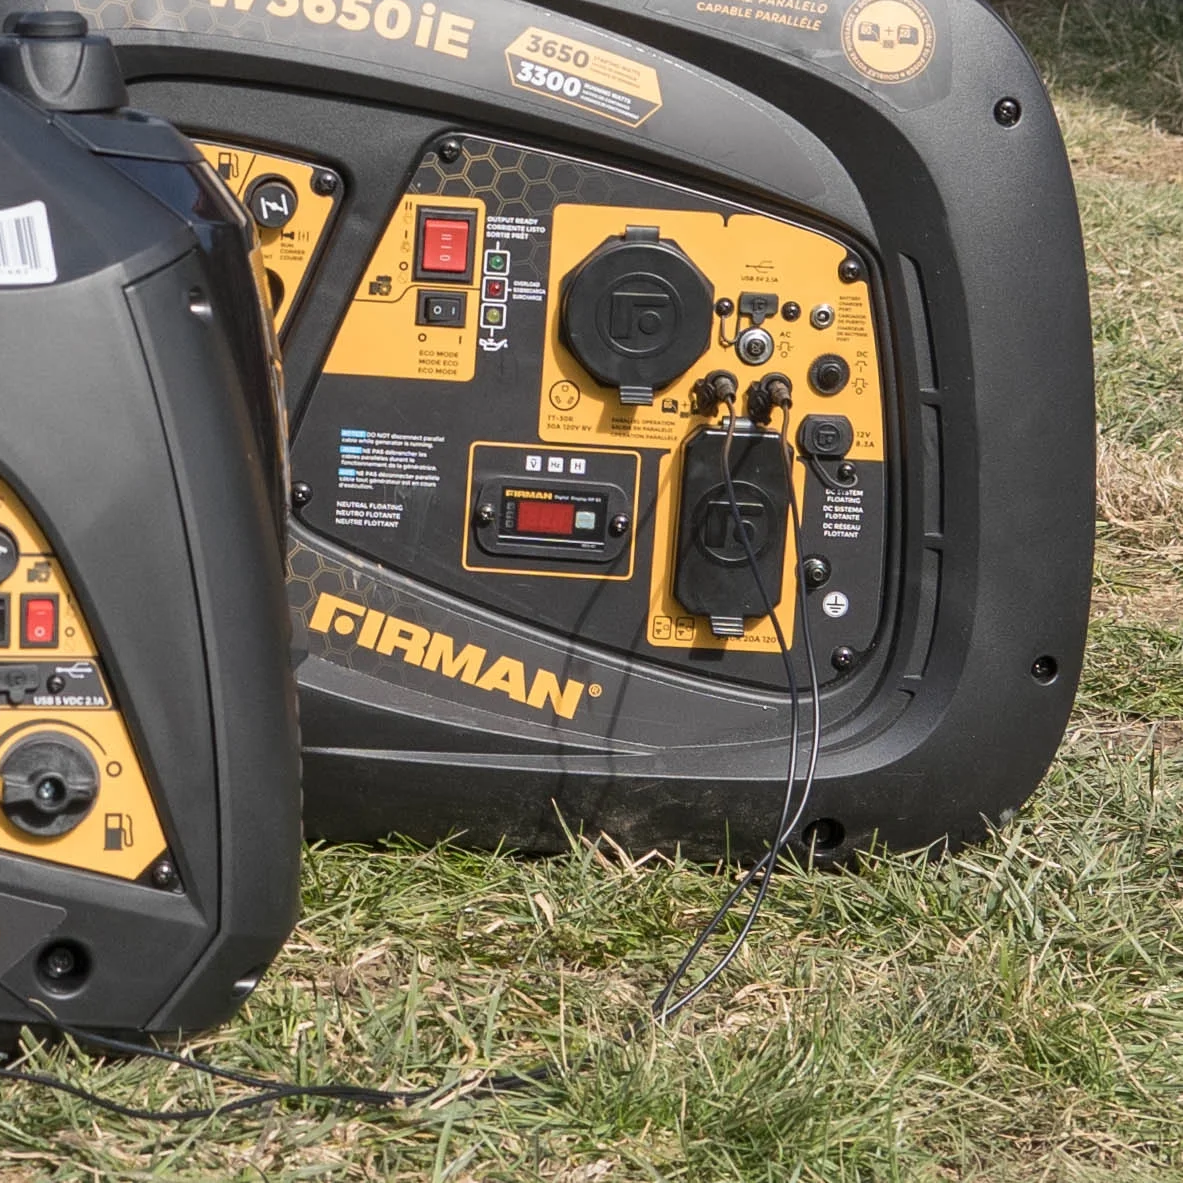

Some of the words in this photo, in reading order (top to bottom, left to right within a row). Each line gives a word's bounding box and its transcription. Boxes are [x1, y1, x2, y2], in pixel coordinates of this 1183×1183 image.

[696, 2, 752, 18] CAPABLE
[526, 34, 589, 68] 3650
[516, 61, 582, 97] 3300
[505, 489, 552, 500] FIRMAN
[337, 501, 368, 509] NEUTRAL
[369, 503, 403, 511] FLOATING
[366, 511, 400, 520] FLOTANTE
[336, 518, 362, 526] NEUTRE
[364, 519, 399, 528] FLOTTANT
[33, 696, 54, 705] USB
[54, 696, 61, 705] 5
[62, 696, 83, 705] VDC
[85, 696, 105, 705] 2.1A
